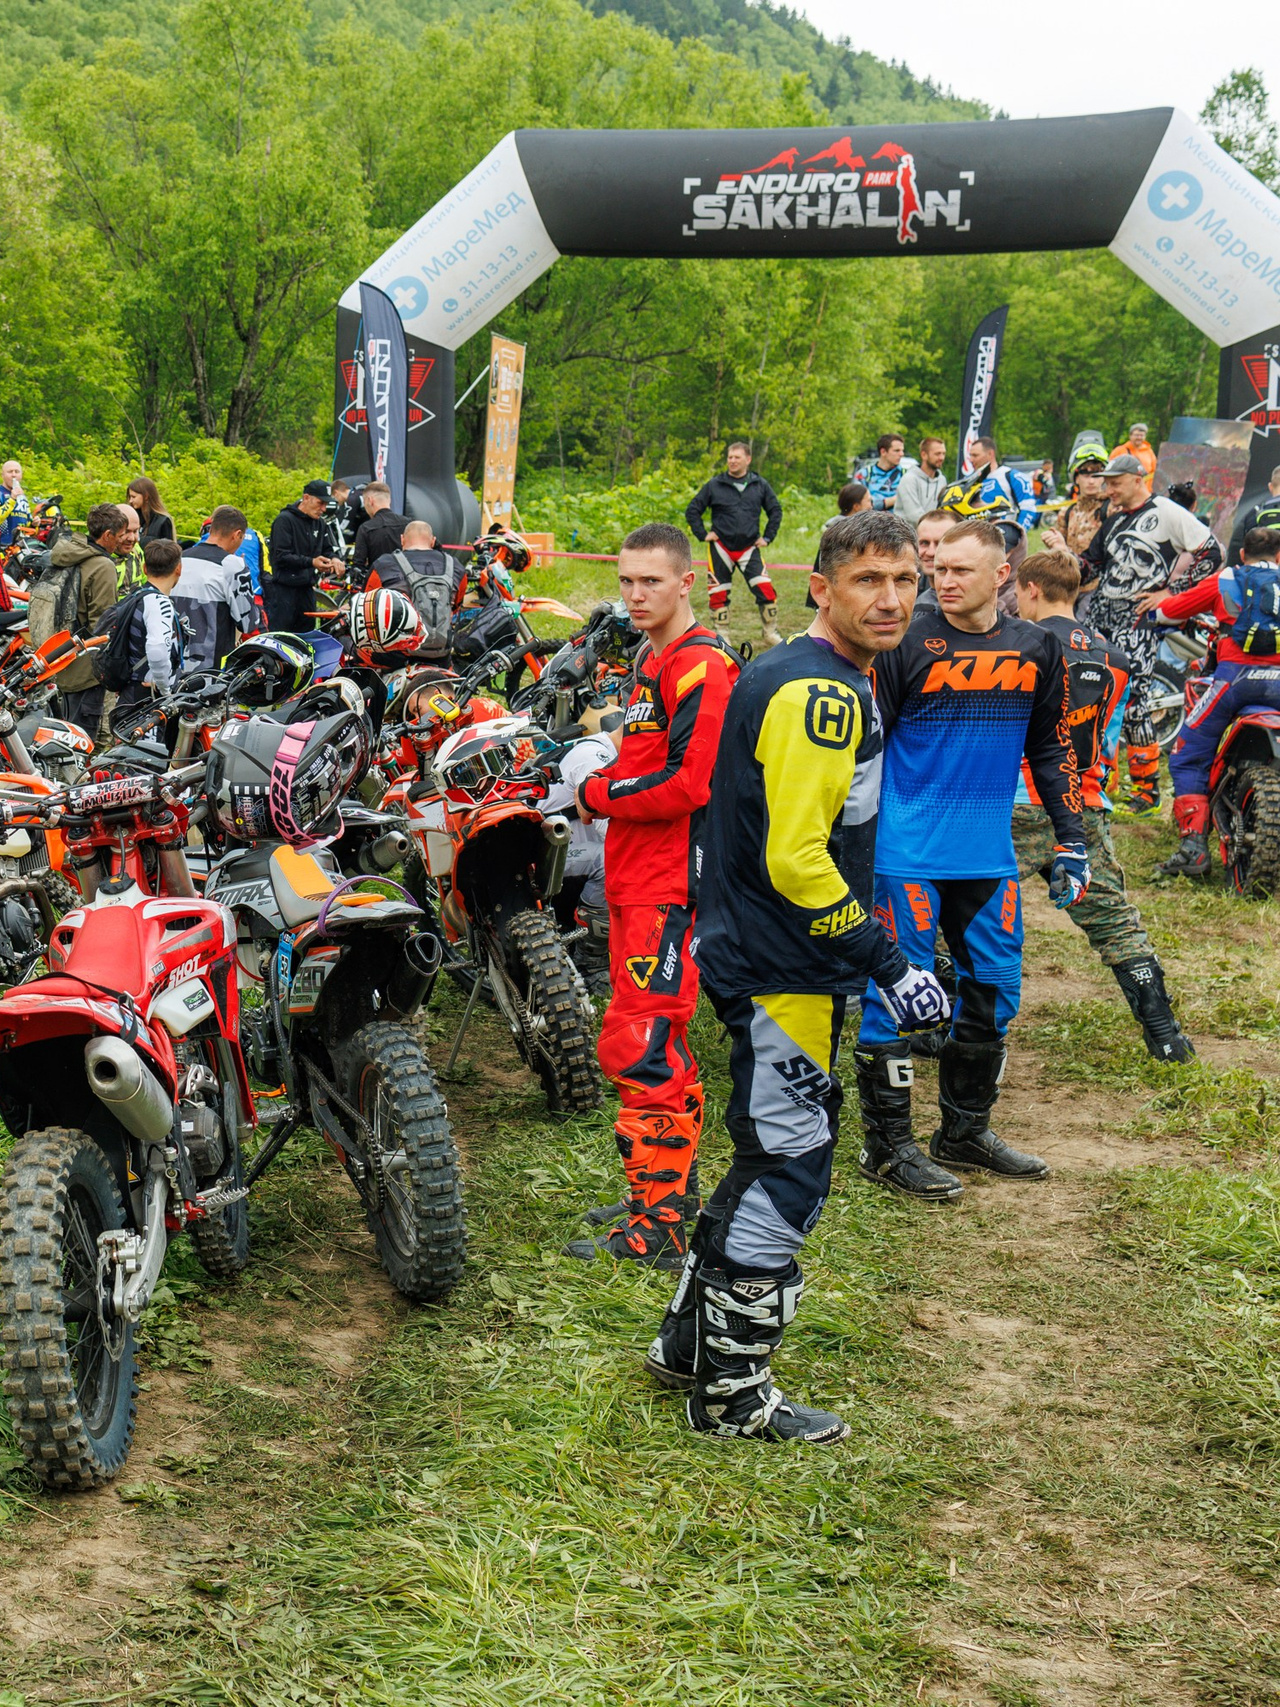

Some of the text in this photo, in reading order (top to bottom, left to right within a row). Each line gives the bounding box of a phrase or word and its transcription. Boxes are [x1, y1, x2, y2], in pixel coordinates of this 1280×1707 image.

[716, 171, 895, 194] ENDURO PARK
[363, 156, 503, 285] едицинский Центр
[692, 185, 963, 236] SAKHALIN
[420, 189, 528, 284] МареМед
[444, 249, 539, 332] www.maremed.ru
[458, 244, 519, 299] 31-13-13
[1132, 240, 1231, 328] www.maremed.ru
[1173, 251, 1240, 309] 31-13-13
[408, 409, 423, 422] UN
[1251, 411, 1267, 426] NO
[921, 651, 1038, 693] KTM
[1080, 670, 1101, 682] KTM
[1069, 704, 1098, 727] KTM
[52, 729, 90, 751] KAYO
[270, 764, 310, 847] 100%
[695, 844, 704, 879] LEATT
[903, 883, 934, 933] KTM
[999, 879, 1019, 935] KTM
[828, 923, 853, 938] RACE
[167, 953, 202, 988] SHOT
[661, 942, 678, 981] LEATT
